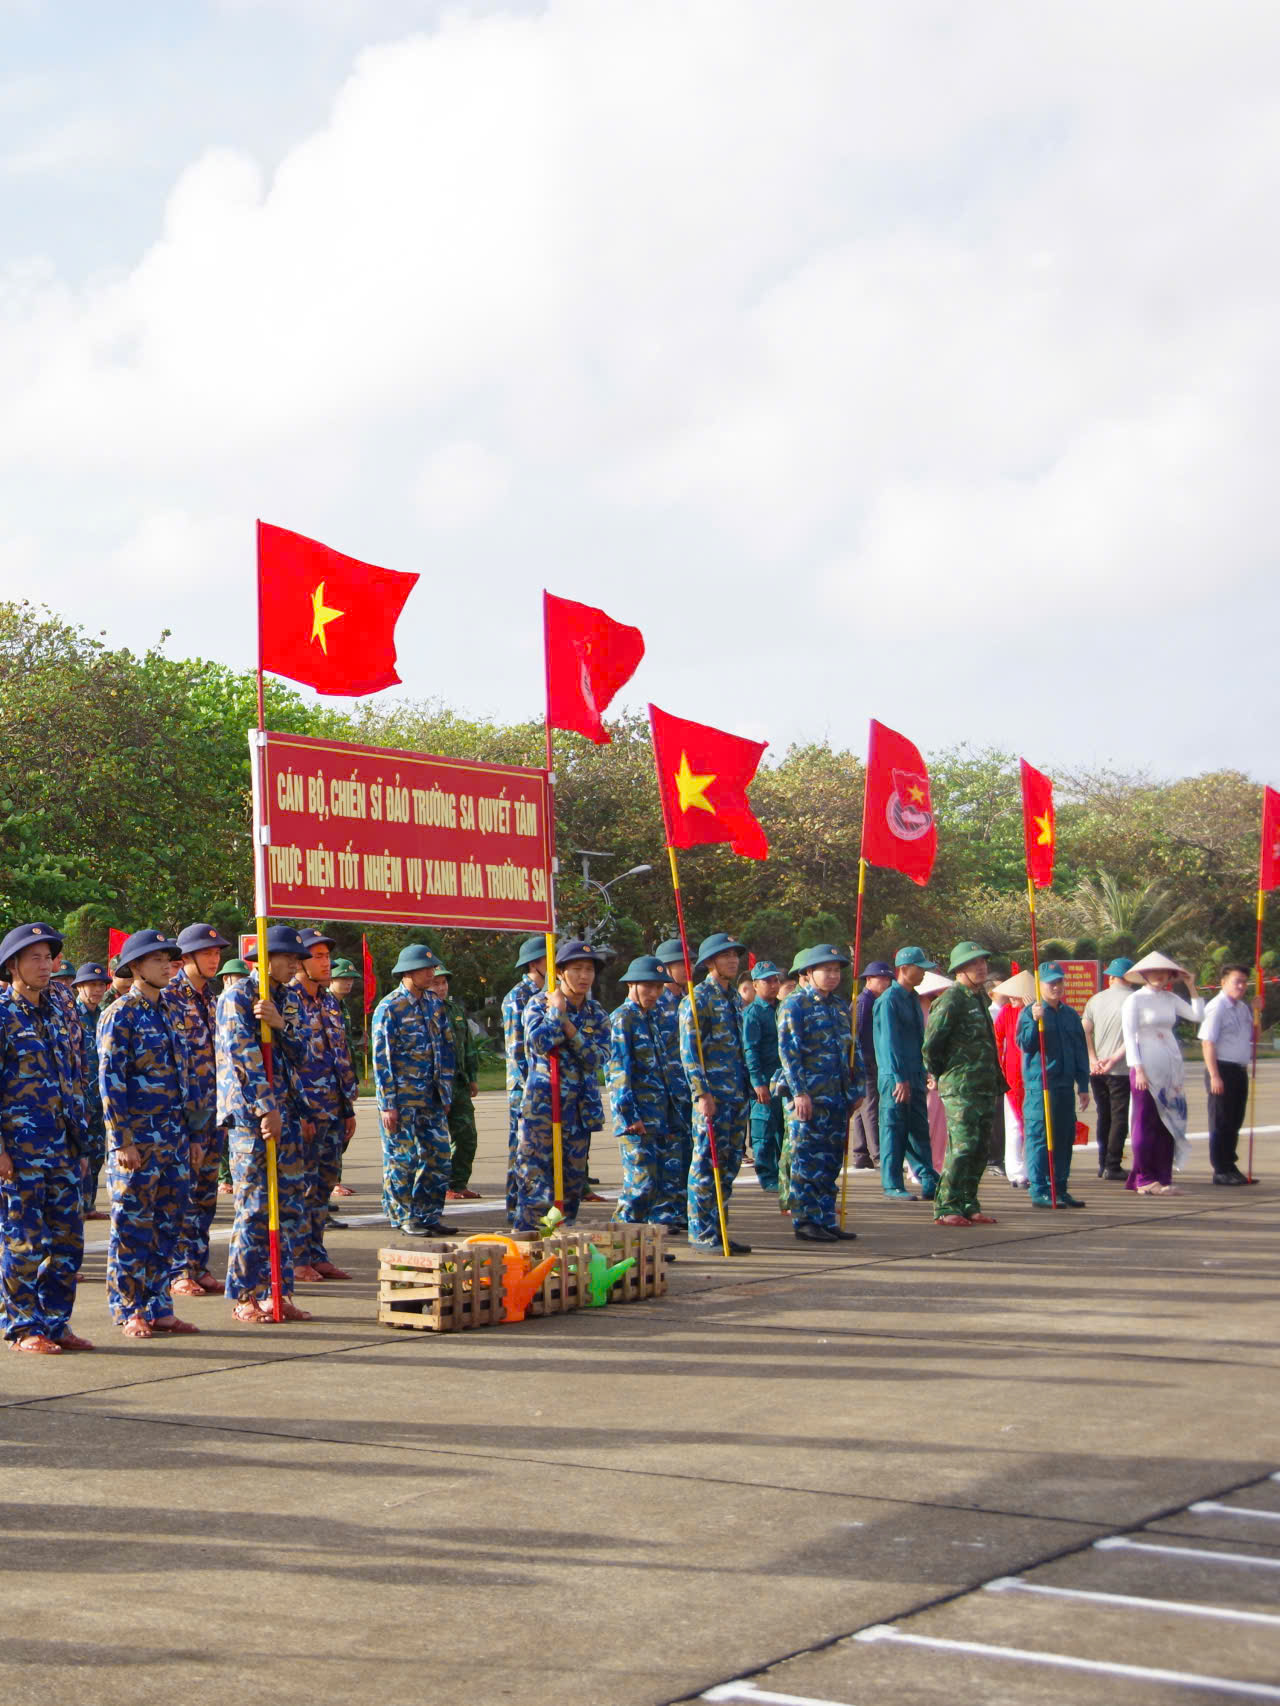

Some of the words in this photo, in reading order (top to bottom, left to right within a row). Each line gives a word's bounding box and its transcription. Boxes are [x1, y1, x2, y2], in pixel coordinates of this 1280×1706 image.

[277, 766, 303, 812] CÁN
[308, 769, 329, 821] BỘ,
[330, 769, 366, 819] CHIẾN
[370, 777, 383, 821] SĨ
[386, 773, 410, 823] ĐẢO
[412, 782, 456, 828] TRƯỜNG
[460, 794, 475, 830] SA
[478, 787, 511, 836] QUYẾT
[514, 795, 537, 837] TÂM
[270, 843, 303, 891] THỰC
[306, 842, 335, 895] HIỆN
[338, 840, 359, 889] TỐT
[364, 849, 403, 898] NHIỆM
[407, 858, 422, 899] VỤ
[425, 860, 457, 896] XANH
[461, 856, 484, 898] HÓA
[486, 858, 529, 900] TRƯỜNG
[532, 868, 547, 902] SA
